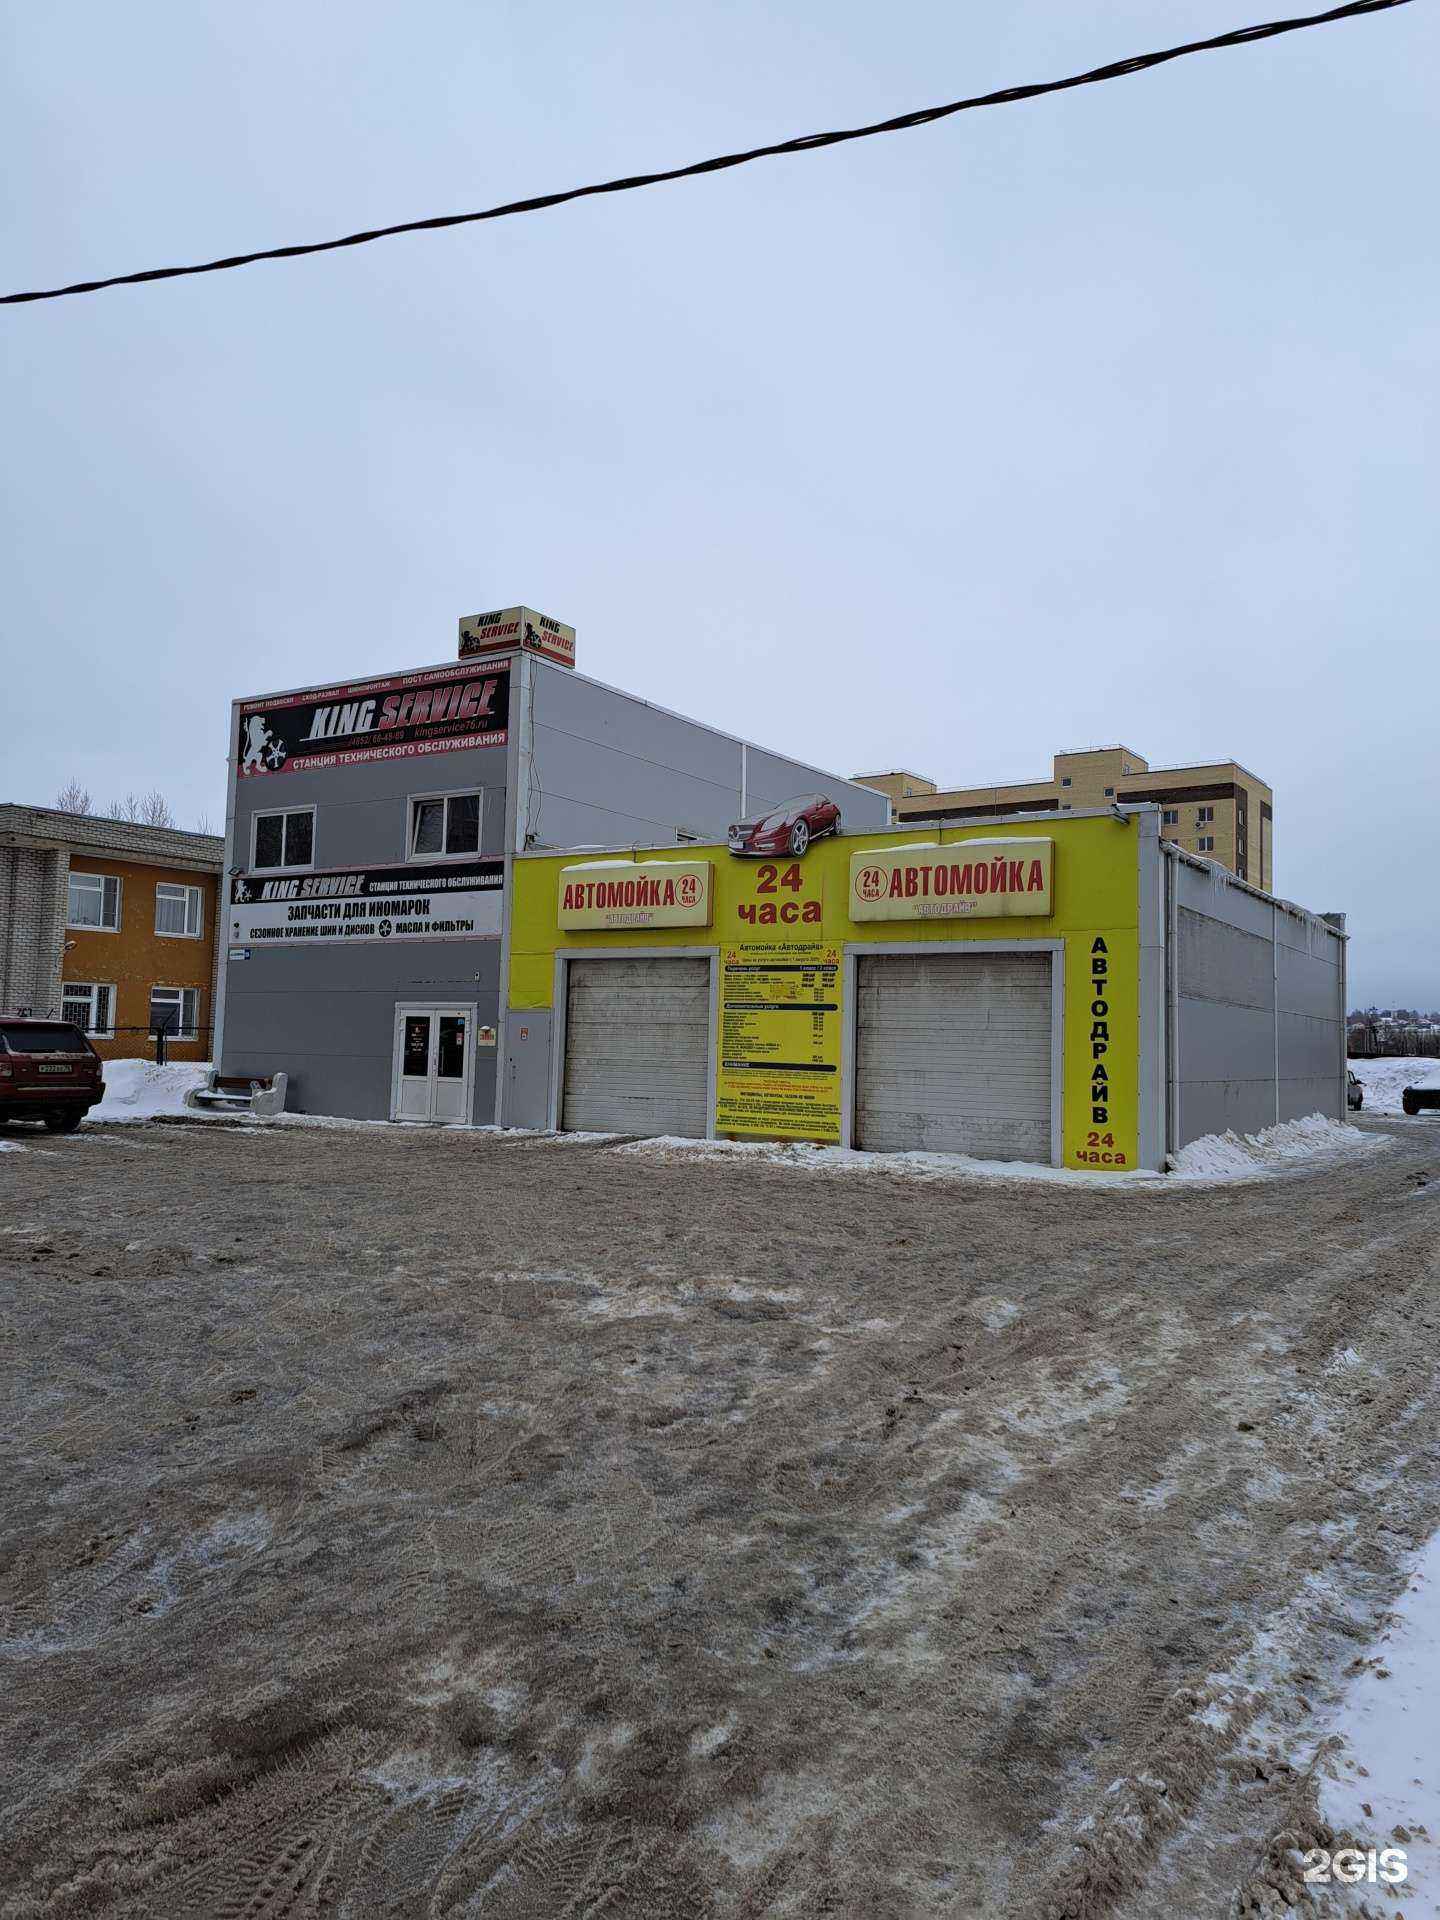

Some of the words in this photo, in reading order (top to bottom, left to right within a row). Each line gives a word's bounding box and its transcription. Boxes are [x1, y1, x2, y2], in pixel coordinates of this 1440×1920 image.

[477, 612, 502, 627] KING
[480, 621, 521, 640] SERVICE
[540, 616, 561, 634] KING
[541, 630, 574, 652] SERVICE
[402, 674, 423, 685] ПОСТ
[424, 661, 509, 680] САМООБСЛУЖИВАНИЯ
[308, 699, 377, 740] KING
[377, 679, 497, 728] SERVICE
[293, 756, 337, 770] СТАНЦИЯ
[339, 745, 415, 764] ТЕХНИЧЕСКОГО
[417, 733, 506, 754] ОБСЛУЖИВАНИЯ
[261, 880, 300, 899] KING
[300, 875, 365, 897] SERVICE
[682, 879, 696, 894] 24
[757, 864, 804, 893] 24
[863, 870, 880, 888] 24
[889, 856, 1044, 898] АВТОМОЙКА
[563, 876, 675, 910] АВТОМОЙКА
[863, 889, 880, 898] ЧАСА
[287, 903, 341, 921] ЗАПЧАСТИ
[343, 902, 367, 920] ДЛЯ
[368, 899, 431, 917] ИНОМАРОК
[738, 901, 822, 924] часа
[250, 927, 284, 939] СЕЗОННОЕ
[285, 925, 319, 938] ХРАНЕНИЕ
[320, 925, 337, 936] ШИН
[338, 925, 343, 935] И
[344, 923, 375, 937] ДИСКОВ
[396, 920, 423, 934] МАСЛА
[424, 921, 430, 932] И
[432, 919, 474, 933] ФИЛЬТРЫ
[827, 949, 837, 957] 24
[1090, 936, 1109, 1123] АВТОДРАЙВ
[1087, 1132, 1115, 1148] 24
[1076, 1151, 1127, 1165] часа
